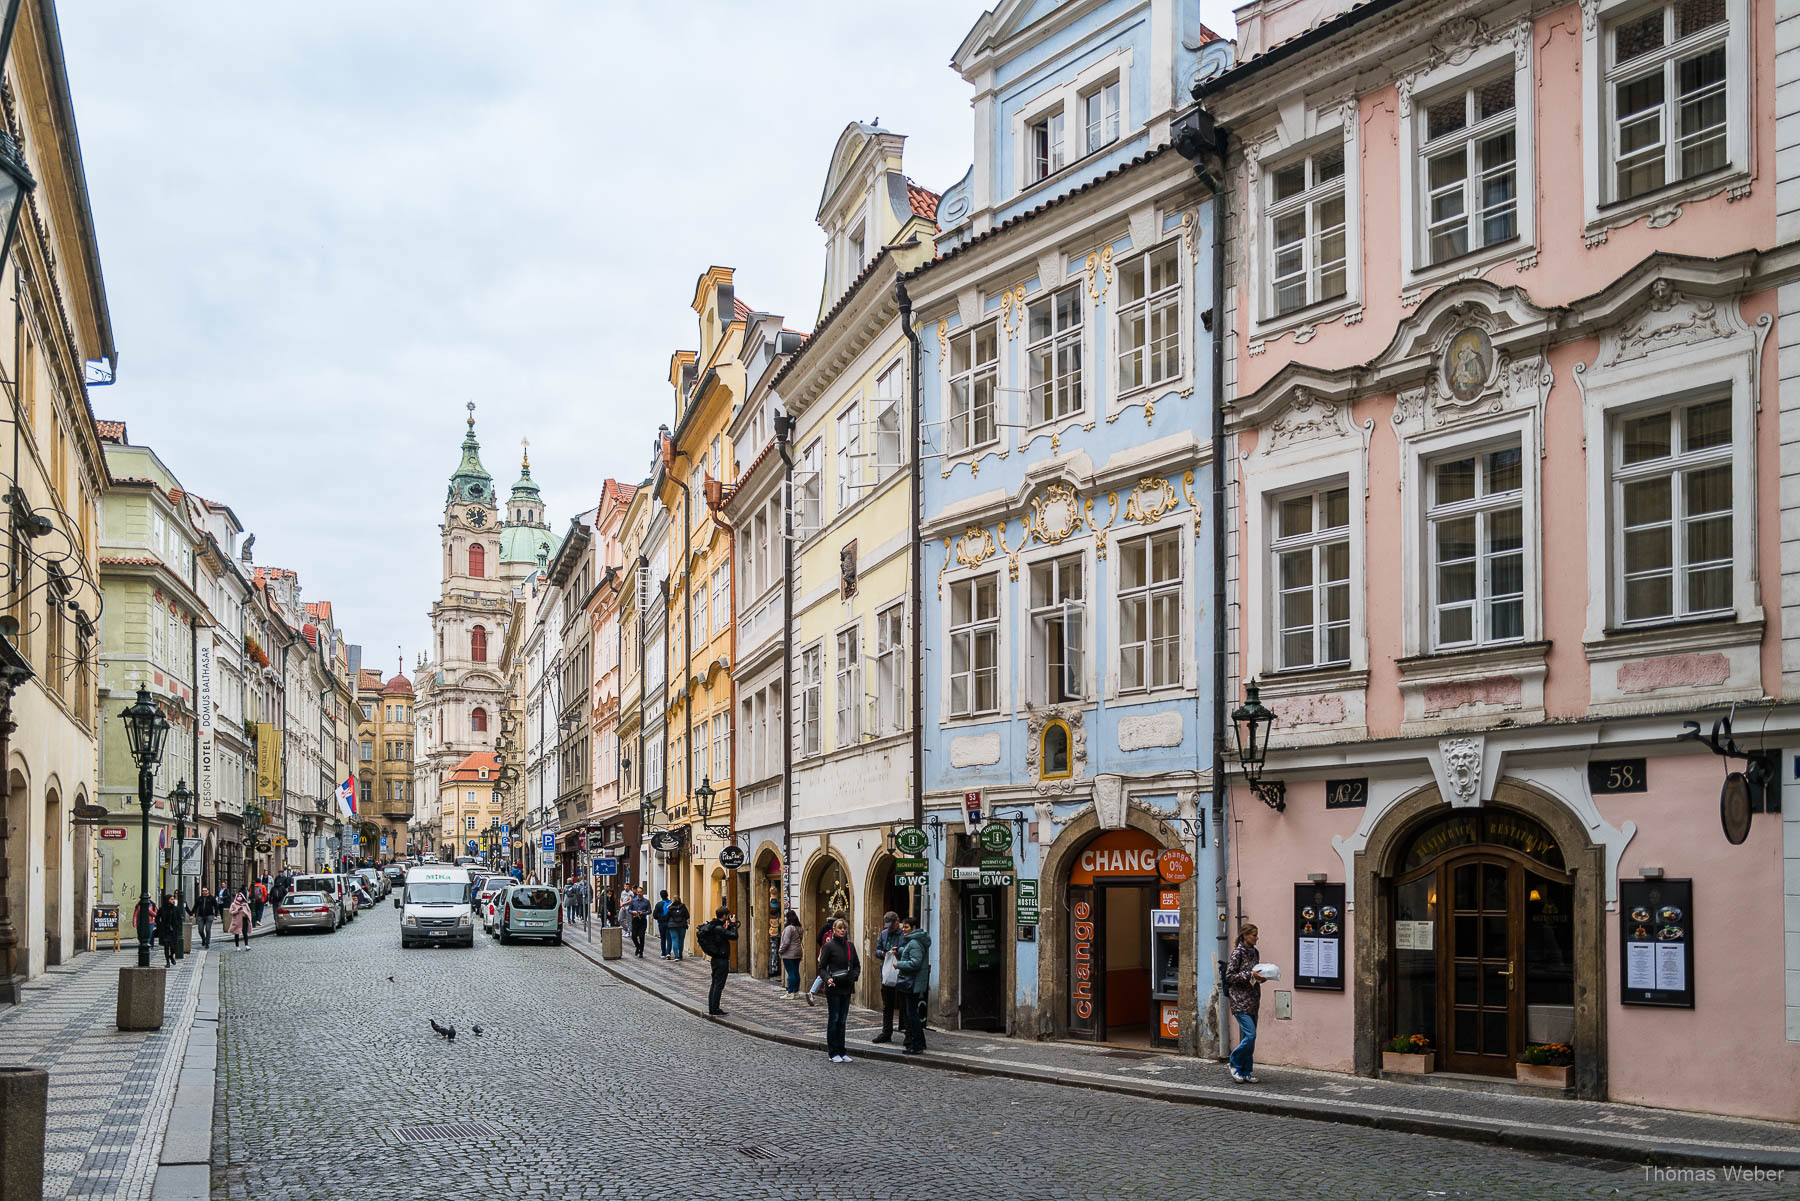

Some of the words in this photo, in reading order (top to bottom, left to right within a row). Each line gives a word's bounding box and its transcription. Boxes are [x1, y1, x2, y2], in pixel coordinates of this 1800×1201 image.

[202, 647, 210, 693] BALTHASAR
[202, 695, 210, 727] DOMUS
[202, 740, 211, 772] HOTEL
[203, 775, 212, 807] DESIGN
[968, 792, 976, 801] 53
[1352, 783, 1362, 801] 2
[899, 828, 916, 838] TOURIST
[916, 829, 926, 838] INFO
[544, 835, 553, 846] P
[1081, 849, 1160, 872] CHANG
[1163, 851, 1189, 863] change
[1169, 860, 1183, 872] 0%
[907, 876, 927, 886] WC
[991, 875, 1011, 886] WC
[1017, 898, 1038, 906] HOSTEL
[1072, 901, 1095, 1019] change
